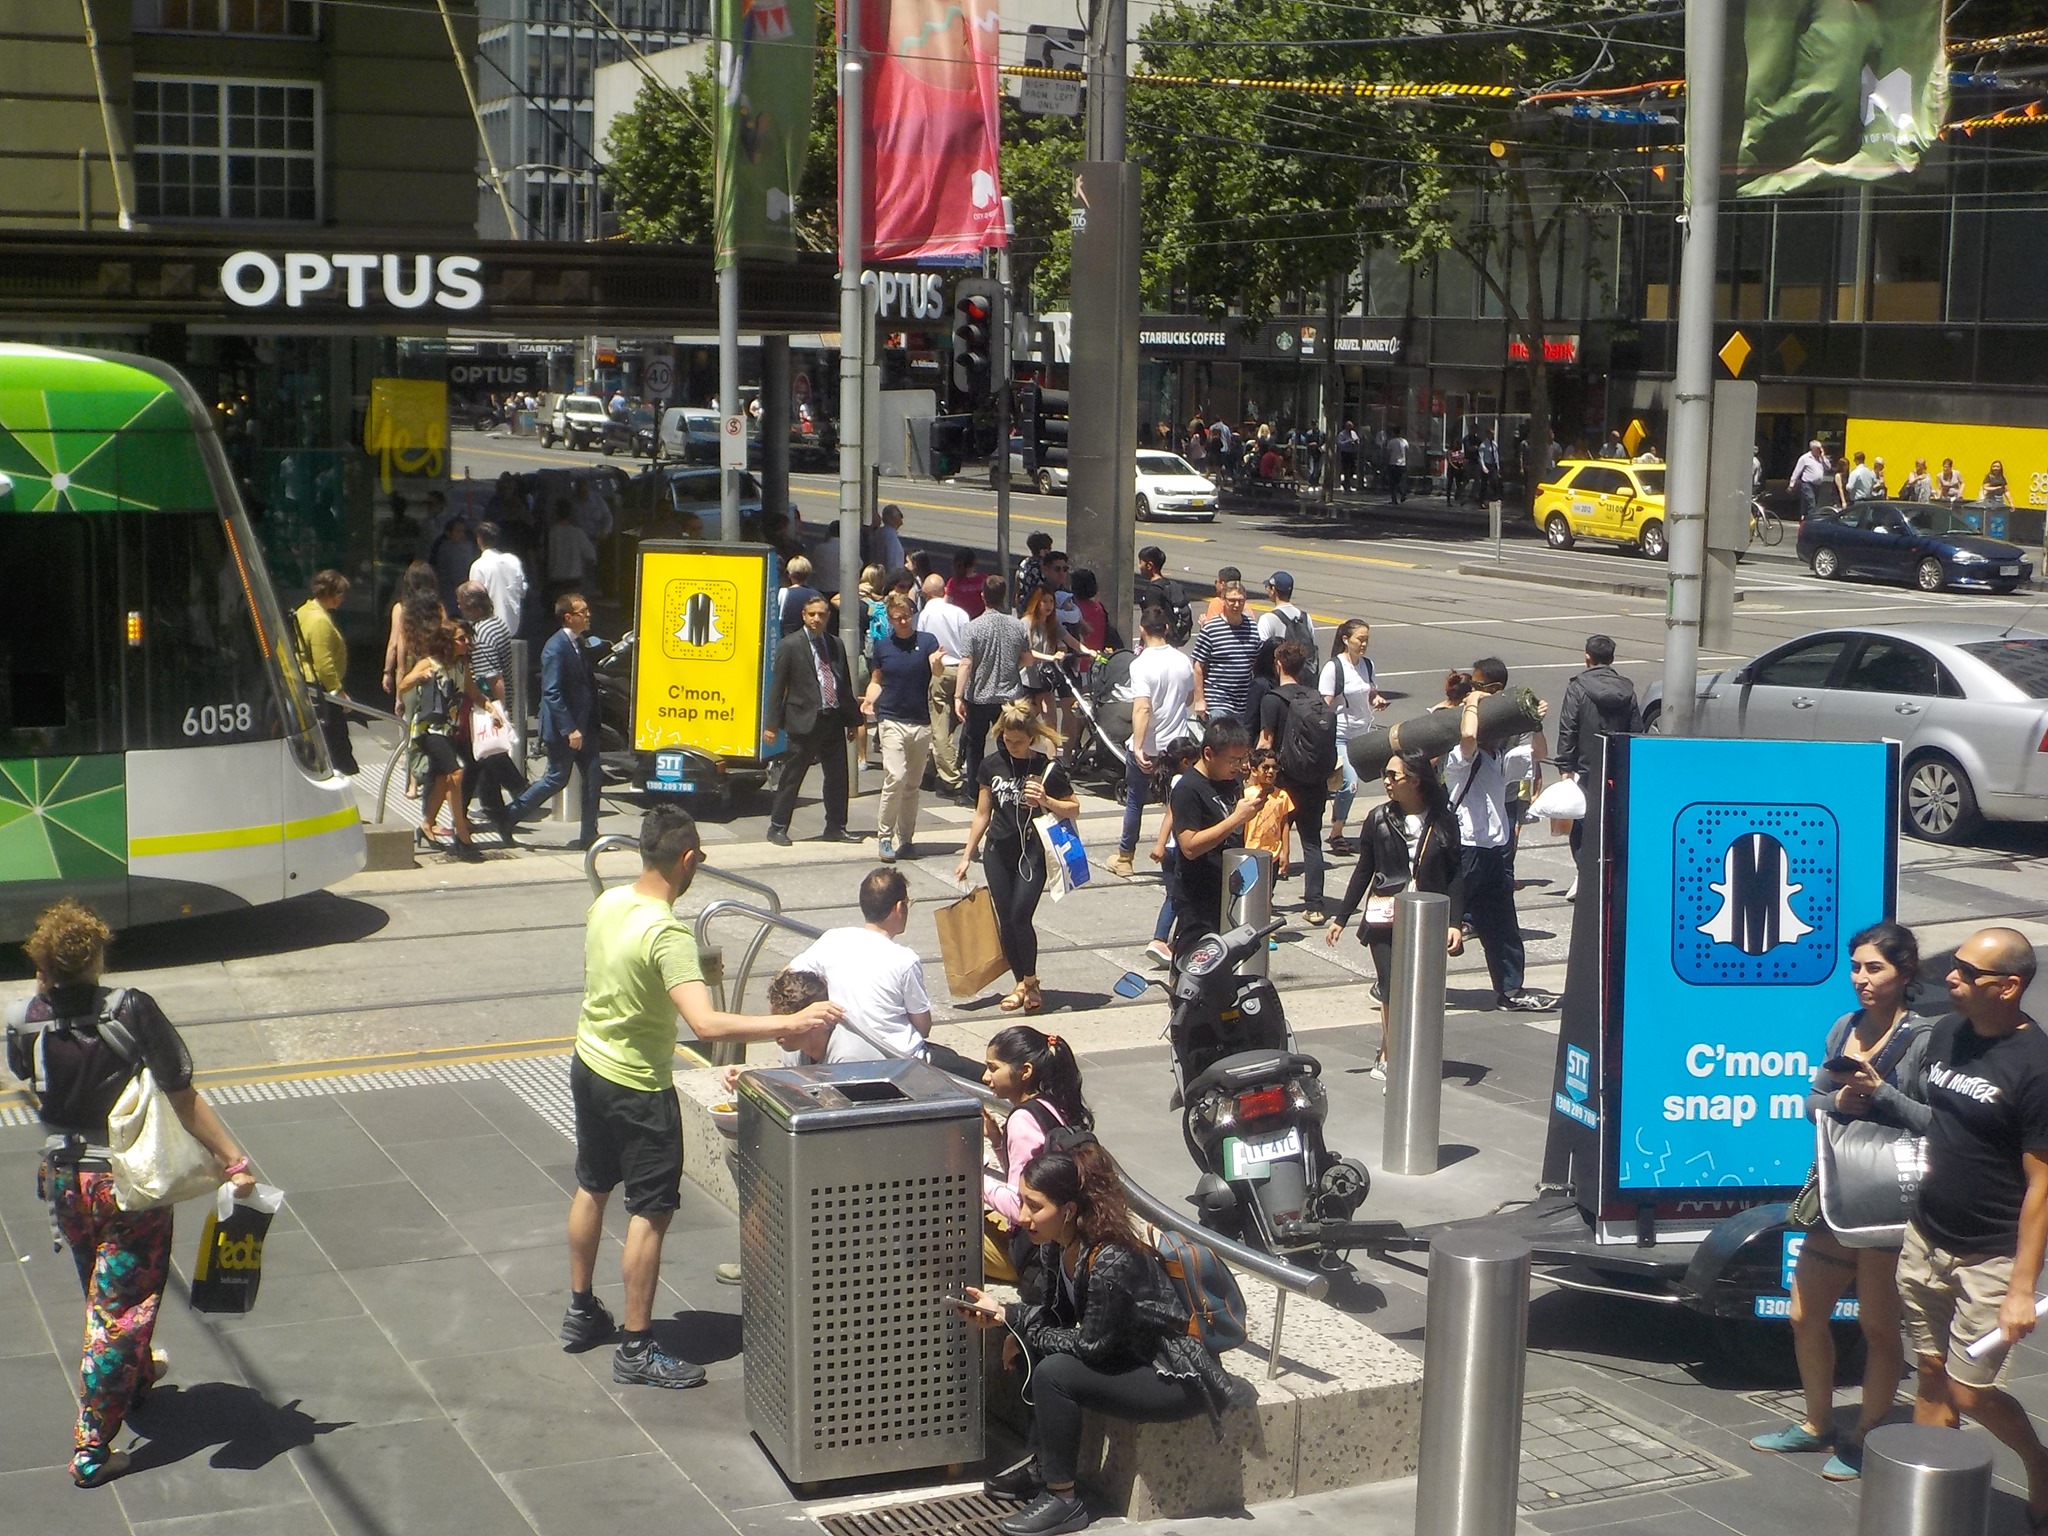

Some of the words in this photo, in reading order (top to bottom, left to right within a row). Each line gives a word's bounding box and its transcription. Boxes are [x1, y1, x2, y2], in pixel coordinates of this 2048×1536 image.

[1025, 90, 1048, 99] FROM
[1054, 92, 1074, 100] LEFT
[1056, 83, 1077, 92] TURN
[1038, 101, 1060, 110] ONLY
[220, 250, 484, 310] OPTUS
[1140, 331, 1190, 345] STARBUCKS
[1191, 332, 1226, 346] COFFEE
[1362, 339, 1389, 351] MONEY
[518, 344, 562, 353] IZABETH
[1543, 337, 1576, 361] bank
[451, 366, 528, 384] OPTUS
[649, 369, 669, 384] 40
[668, 685, 726, 705] C'mon,
[182, 703, 251, 737] 6058
[658, 706, 698, 722] snap
[704, 707, 735, 722] me!
[657, 756, 682, 770] STT
[1568, 1050, 1588, 1080] STT
[1686, 1043, 1818, 1083] C'mon,
[1946, 1073, 2001, 1104] MATTER
[1663, 1094, 1757, 1127] snap
[1769, 1094, 1805, 1120] m
